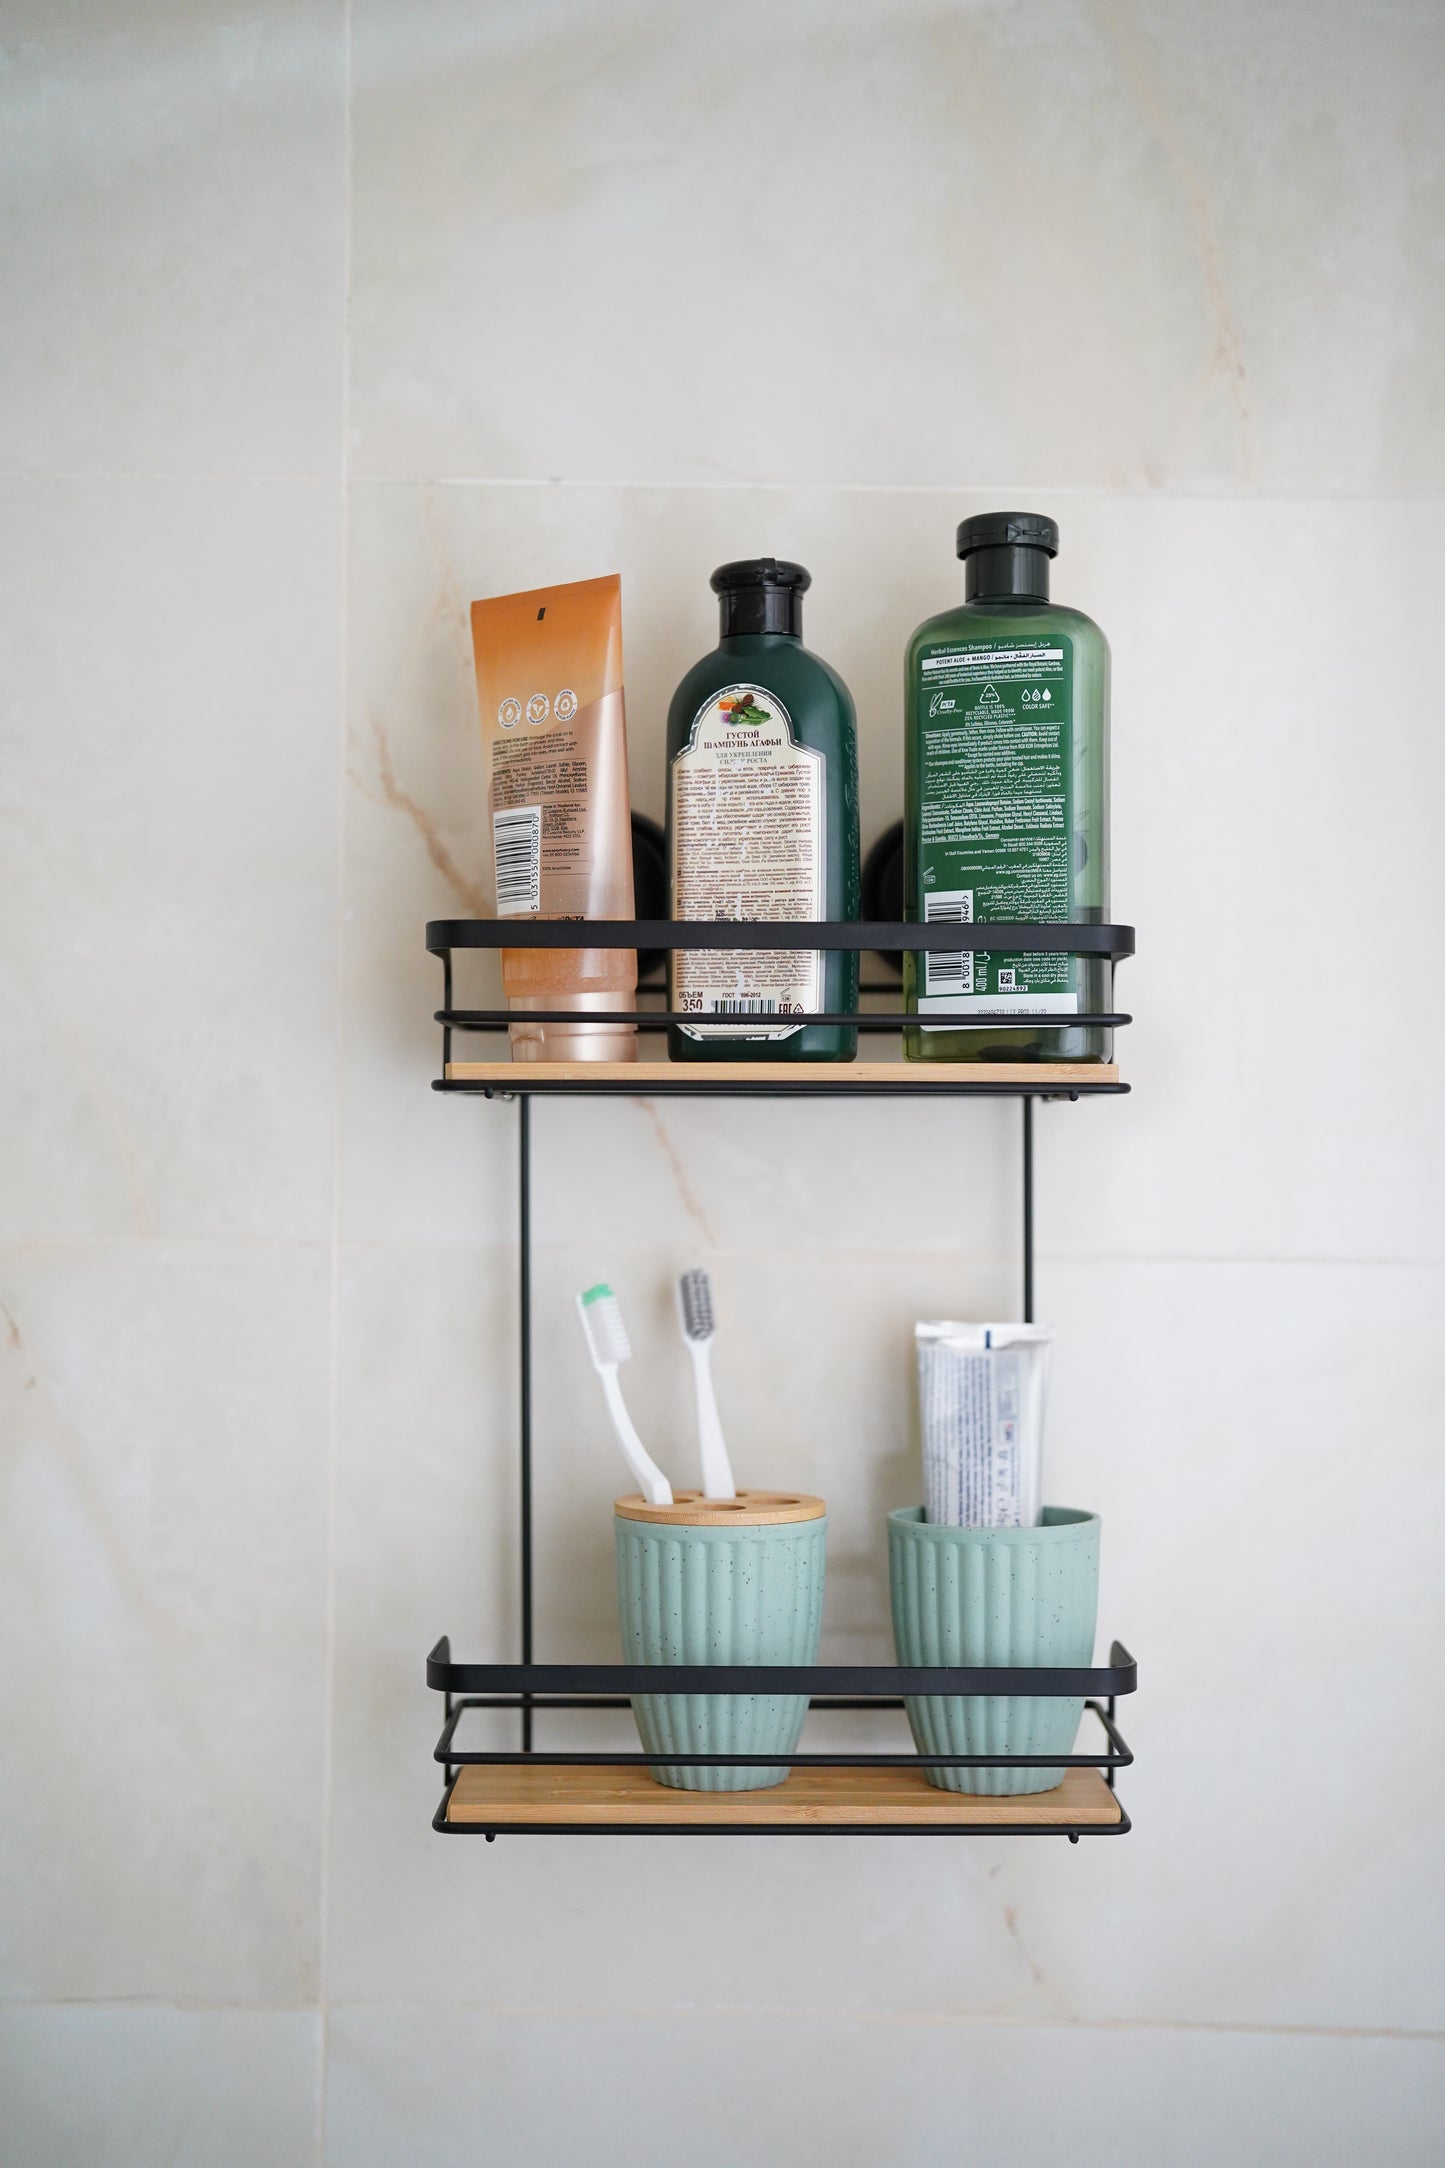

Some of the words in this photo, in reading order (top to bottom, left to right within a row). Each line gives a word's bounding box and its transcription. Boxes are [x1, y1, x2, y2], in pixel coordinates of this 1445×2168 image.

[968, 644, 992, 652] Shampoo
[726, 730, 759, 739] ГУСТОЙ
[704, 740, 748, 749] ШАМПУНЬ
[532, 816, 540, 854] 000870
[531, 859, 539, 896] 031550
[976, 965, 987, 976] ml
[976, 977, 987, 991] 400
[683, 999, 703, 1011] 350
